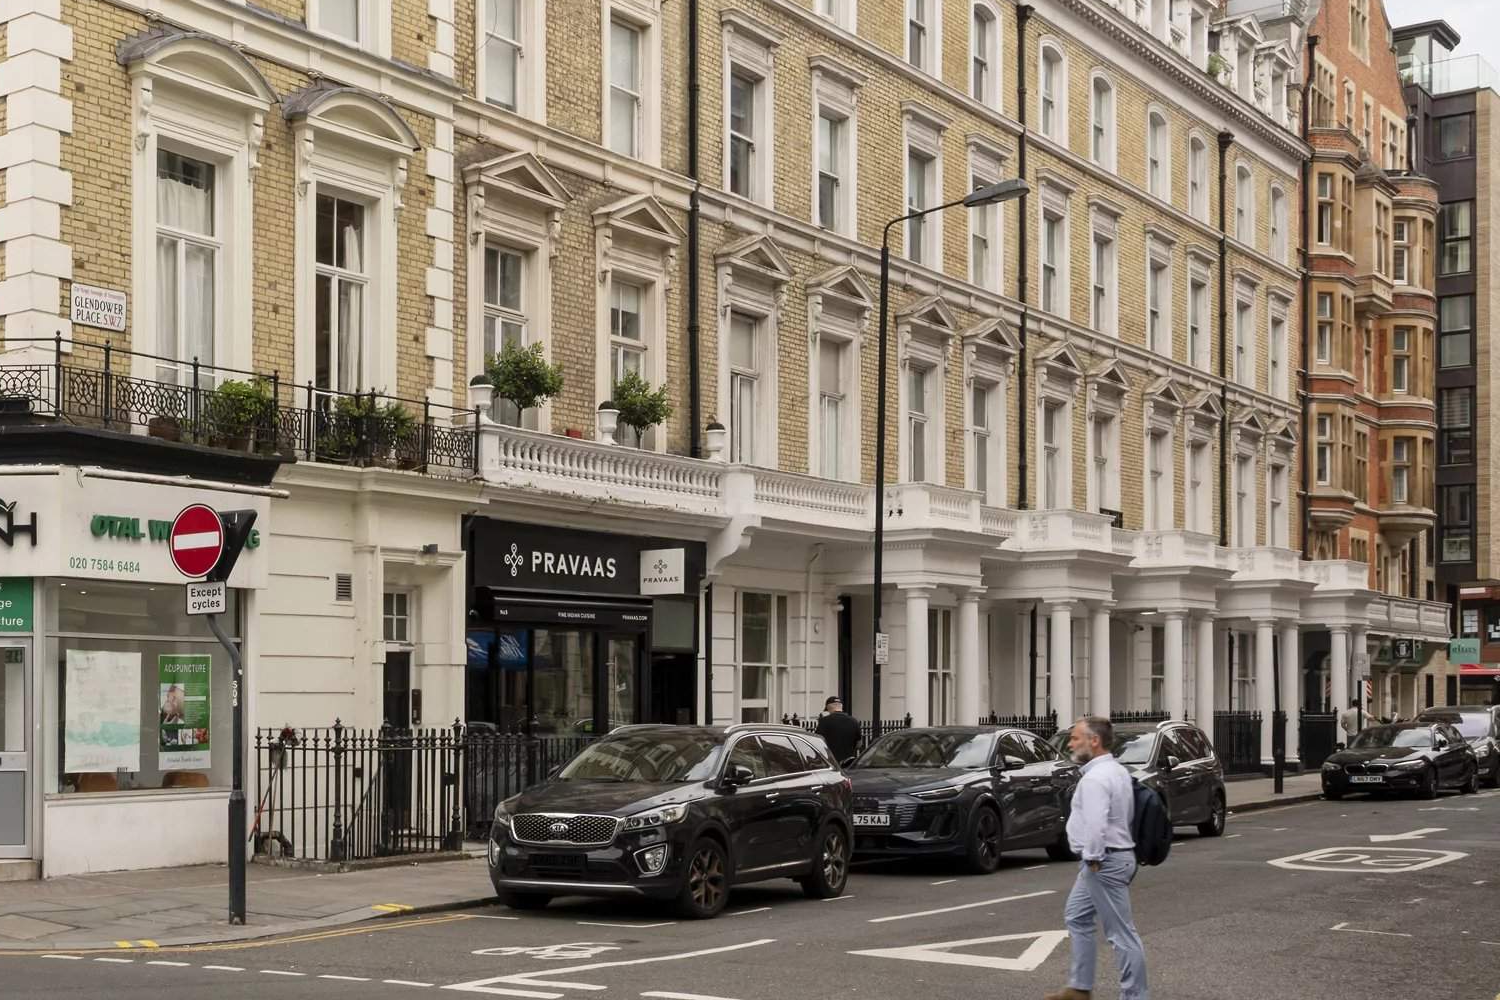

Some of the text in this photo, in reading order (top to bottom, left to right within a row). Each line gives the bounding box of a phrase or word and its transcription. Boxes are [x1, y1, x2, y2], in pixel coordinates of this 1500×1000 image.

[74, 295, 123, 316] GLENDOWER
[69, 556, 141, 573] 020 7584 6484
[531, 551, 617, 578] PRAVAAS
[643, 576, 680, 584] PRAVAAS
[190, 586, 222, 598] Except
[191, 598, 221, 610] cycles
[163, 663, 206, 673] ACUPUNCTURE
[870, 815, 888, 825] KAJ
